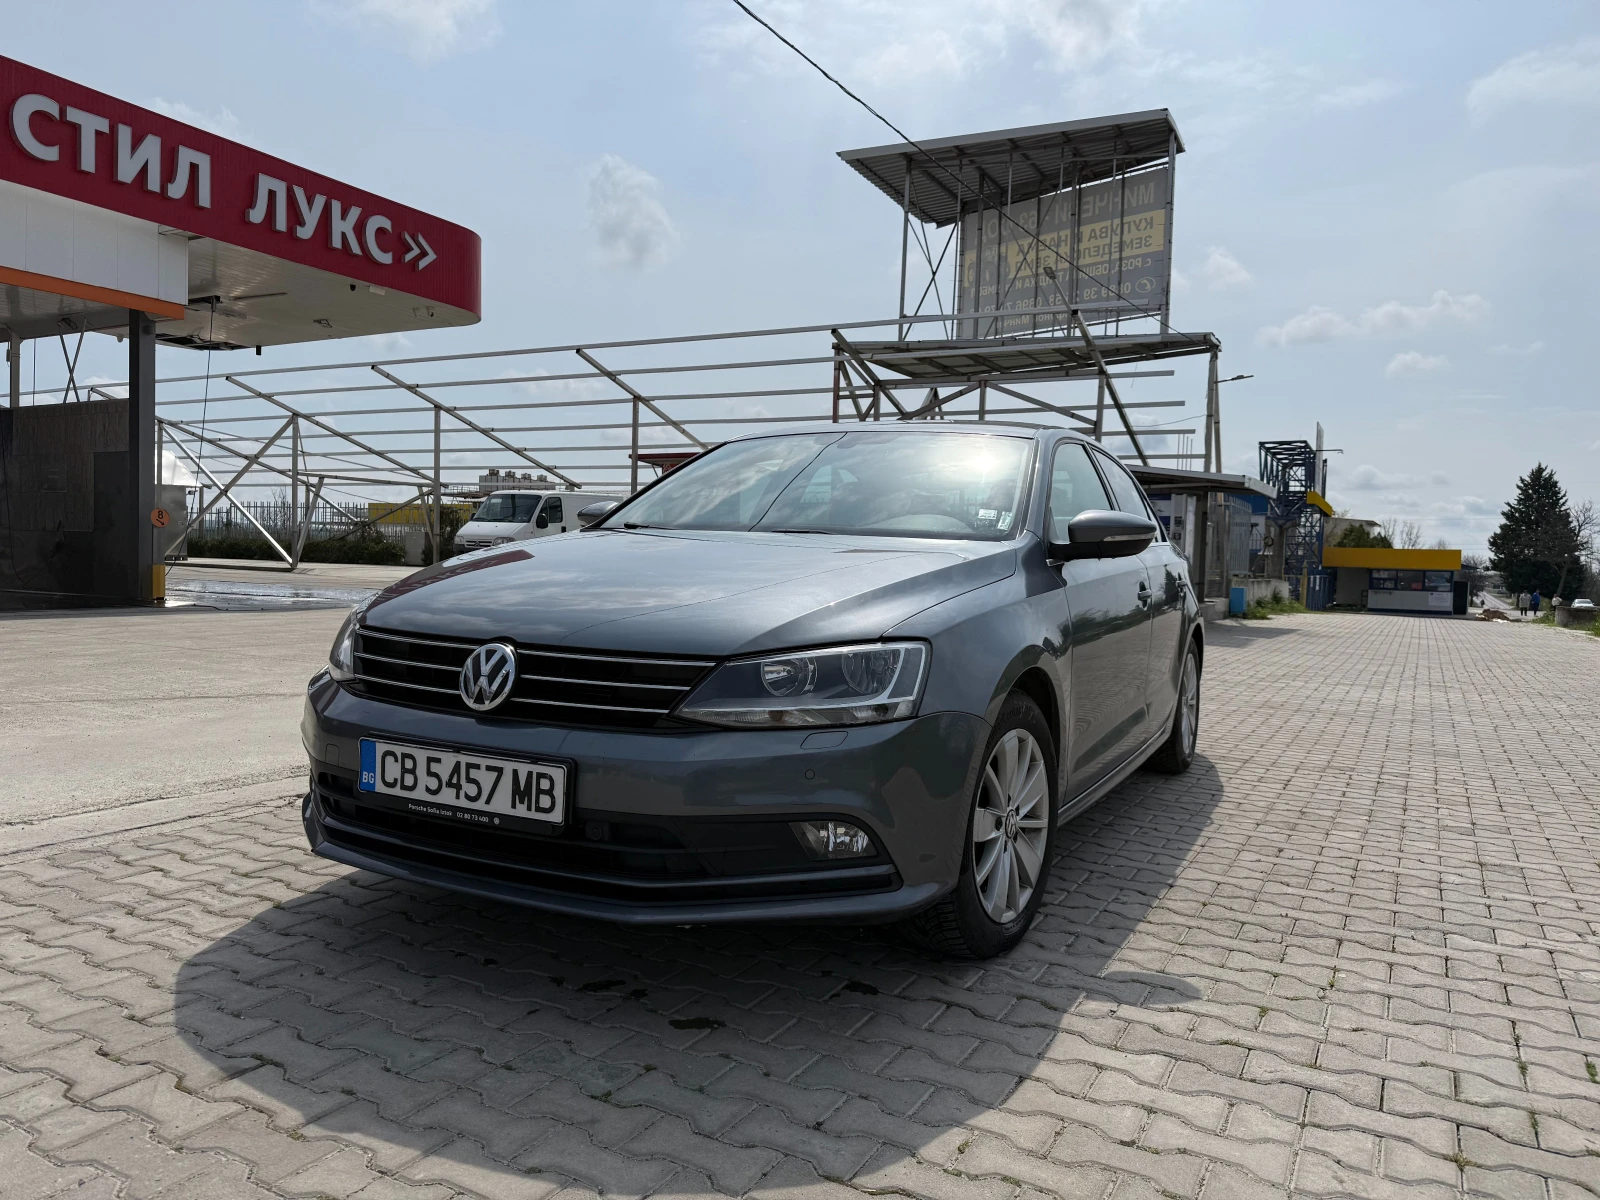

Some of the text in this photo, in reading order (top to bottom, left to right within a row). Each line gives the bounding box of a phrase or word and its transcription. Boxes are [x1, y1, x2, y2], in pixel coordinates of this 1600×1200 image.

[10, 93, 394, 265] СТИЛ ЛУКС
[157, 510, 164, 520] 8
[362, 771, 375, 784] BG
[380, 750, 556, 813] CB 5457 MB
[479, 815, 489, 823] 400
